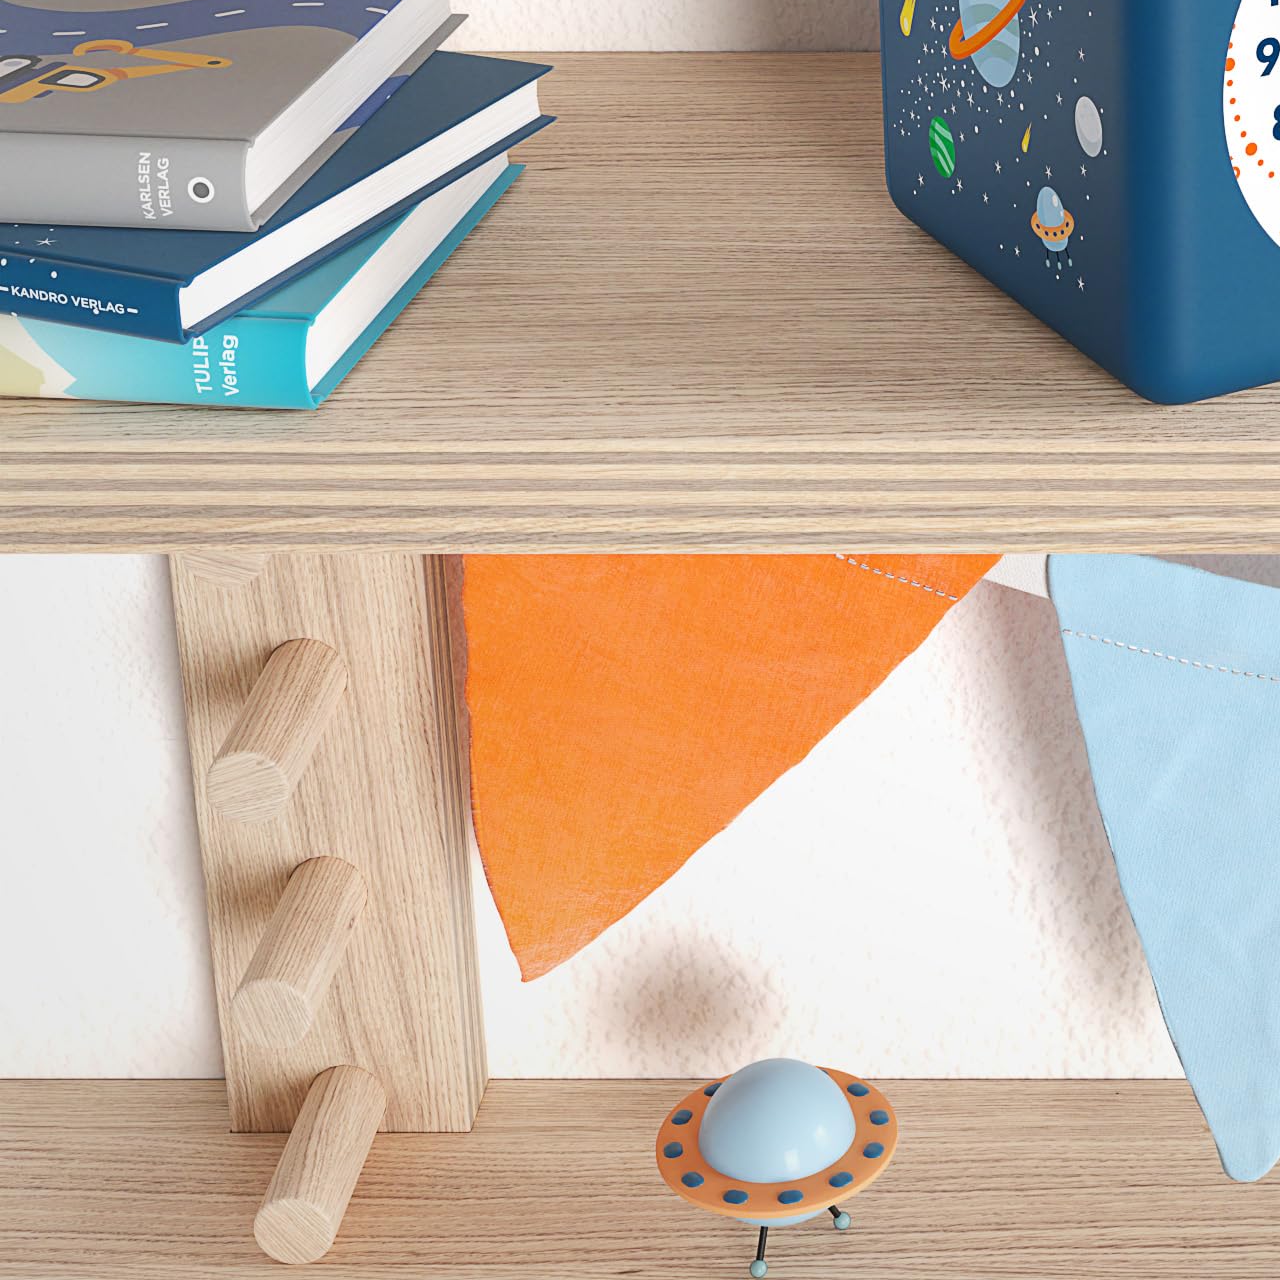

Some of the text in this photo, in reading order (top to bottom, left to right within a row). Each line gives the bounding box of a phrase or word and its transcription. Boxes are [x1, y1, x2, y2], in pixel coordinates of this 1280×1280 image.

[1255, 37, 1280, 77] 9
[138, 151, 157, 220] KARLSEN
[157, 157, 174, 217] VERLAG
[10, 285, 125, 315] KANDRO VERLAG
[193, 336, 213, 394] TULIP
[219, 335, 240, 396] Verlag
